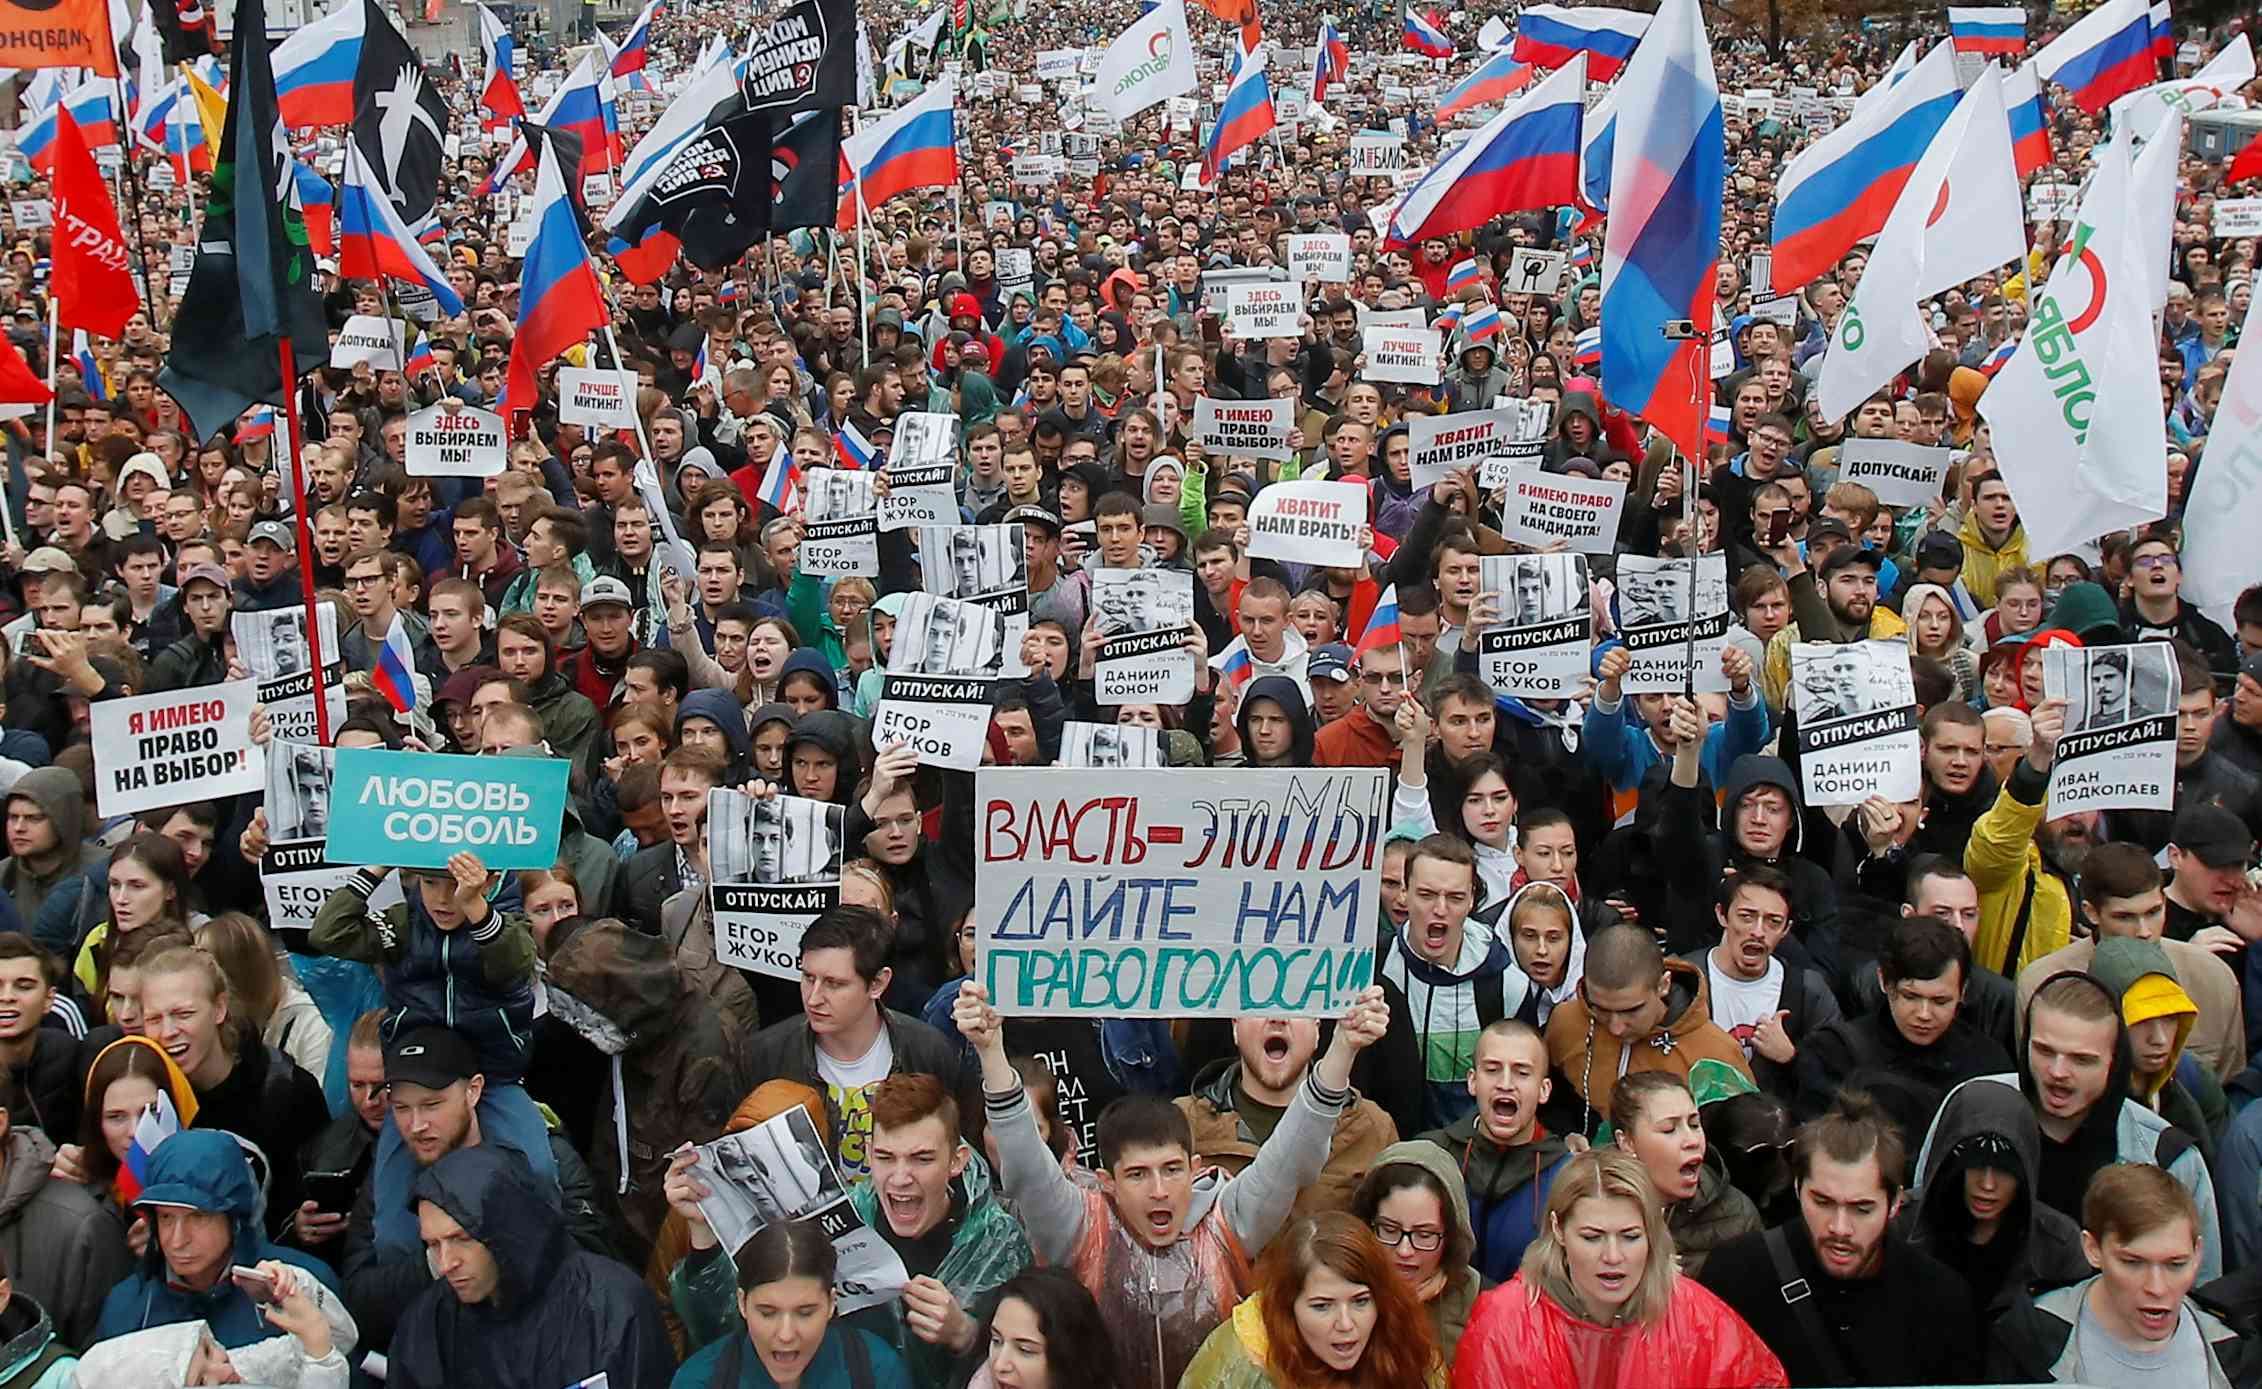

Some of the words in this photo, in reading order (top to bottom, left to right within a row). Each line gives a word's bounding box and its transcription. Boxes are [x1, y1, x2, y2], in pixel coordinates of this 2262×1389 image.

[753, 67, 795, 97] ЦИЯ
[1293, 251, 1343, 262] ВЫБИРАЕМ
[1247, 291, 1281, 302] ЗДЕСЬ
[1234, 303, 1297, 316] ВЫБИРАЕМ
[1254, 317, 1279, 328] МЫ!
[1382, 341, 1423, 353] ЛУЧШЕ
[1376, 354, 1427, 367] МИТИНГ!
[2029, 295, 2098, 447] ЯБЛО
[578, 382, 620, 396] ЛУЧШЕ
[573, 394, 624, 411] МИТИНГ!
[434, 415, 480, 430] ЗДЕСЬ
[1214, 408, 1223, 421] Я
[1226, 408, 1273, 422] ИМЕЮ
[1219, 423, 1267, 436] ПРАВО
[1435, 422, 1494, 446] ХВАТИТ
[415, 432, 498, 448] ВЫБИРАЕМ
[1203, 435, 1223, 448] НА
[1226, 436, 1284, 449] ВЫБОР!
[440, 448, 472, 463] МЫ!
[1416, 445, 1452, 465] НАМ
[1456, 434, 1508, 460] ВРАТЬ!
[888, 469, 946, 486] ТПУСКАЙ!
[1849, 461, 1938, 483] ДОПУСКАЙ!
[883, 497, 917, 509] ЕГОР
[1519, 483, 1526, 496] Я
[1528, 486, 1568, 502] ИМЕЮ
[1571, 494, 1613, 508] ПРАВО
[883, 508, 936, 521] ЖУКОВ
[1276, 498, 1342, 519] ХВАТИТ
[1530, 501, 1546, 515] НА
[1550, 505, 1597, 522] СВОЕГО
[807, 521, 873, 538] ОТПУСКАЙ!
[1256, 515, 1297, 534] НАМ
[1300, 518, 1357, 541] ВРАТЬ!
[1520, 515, 1601, 537] КАНДИДАТА!
[807, 547, 842, 559] ЕГОР
[807, 558, 859, 571] ЖУКОВ
[1103, 632, 1186, 656] ОТПУСКАЙ!
[1492, 627, 1580, 649] ОТПУСКАЙ!
[1104, 669, 1171, 682] ДАНИИЛ
[1493, 661, 1538, 674] ЕГОР
[257, 670, 333, 701] ТПУСКА!
[891, 682, 985, 700] ОТПУСКАЙ!
[1104, 683, 1159, 696] КОНОН
[1492, 674, 1561, 690] ЖУКОВ
[129, 712, 144, 736] Я
[150, 699, 225, 732] ИМЕЮ
[885, 710, 931, 732] ЕГОР
[274, 725, 319, 739] КОВ
[1809, 711, 1906, 748] ОТПУСКАЙ!
[139, 728, 219, 761] ПРАВО
[2058, 721, 2163, 760] ОТПУСКАЙ!
[115, 769, 150, 793] НА
[154, 750, 247, 787] ВЫБОР!
[1813, 760, 1891, 776] ДАНИИЛ
[1814, 777, 1878, 792] КОНОН
[2057, 770, 2100, 788] ИВАН
[360, 775, 531, 812] ЛЮБОВЬ
[2057, 783, 2160, 804] ПОДКОПАЕВ
[384, 812, 538, 845] СОБОЛЬ
[274, 847, 322, 868] ОТПУ
[726, 890, 827, 909] ОТПУСКАЙ!
[990, 874, 1199, 941] ДАЙТЕ
[1233, 877, 1361, 945] НАМ
[728, 922, 779, 944] ЕГОР
[987, 947, 1147, 1010] ПРАВО
